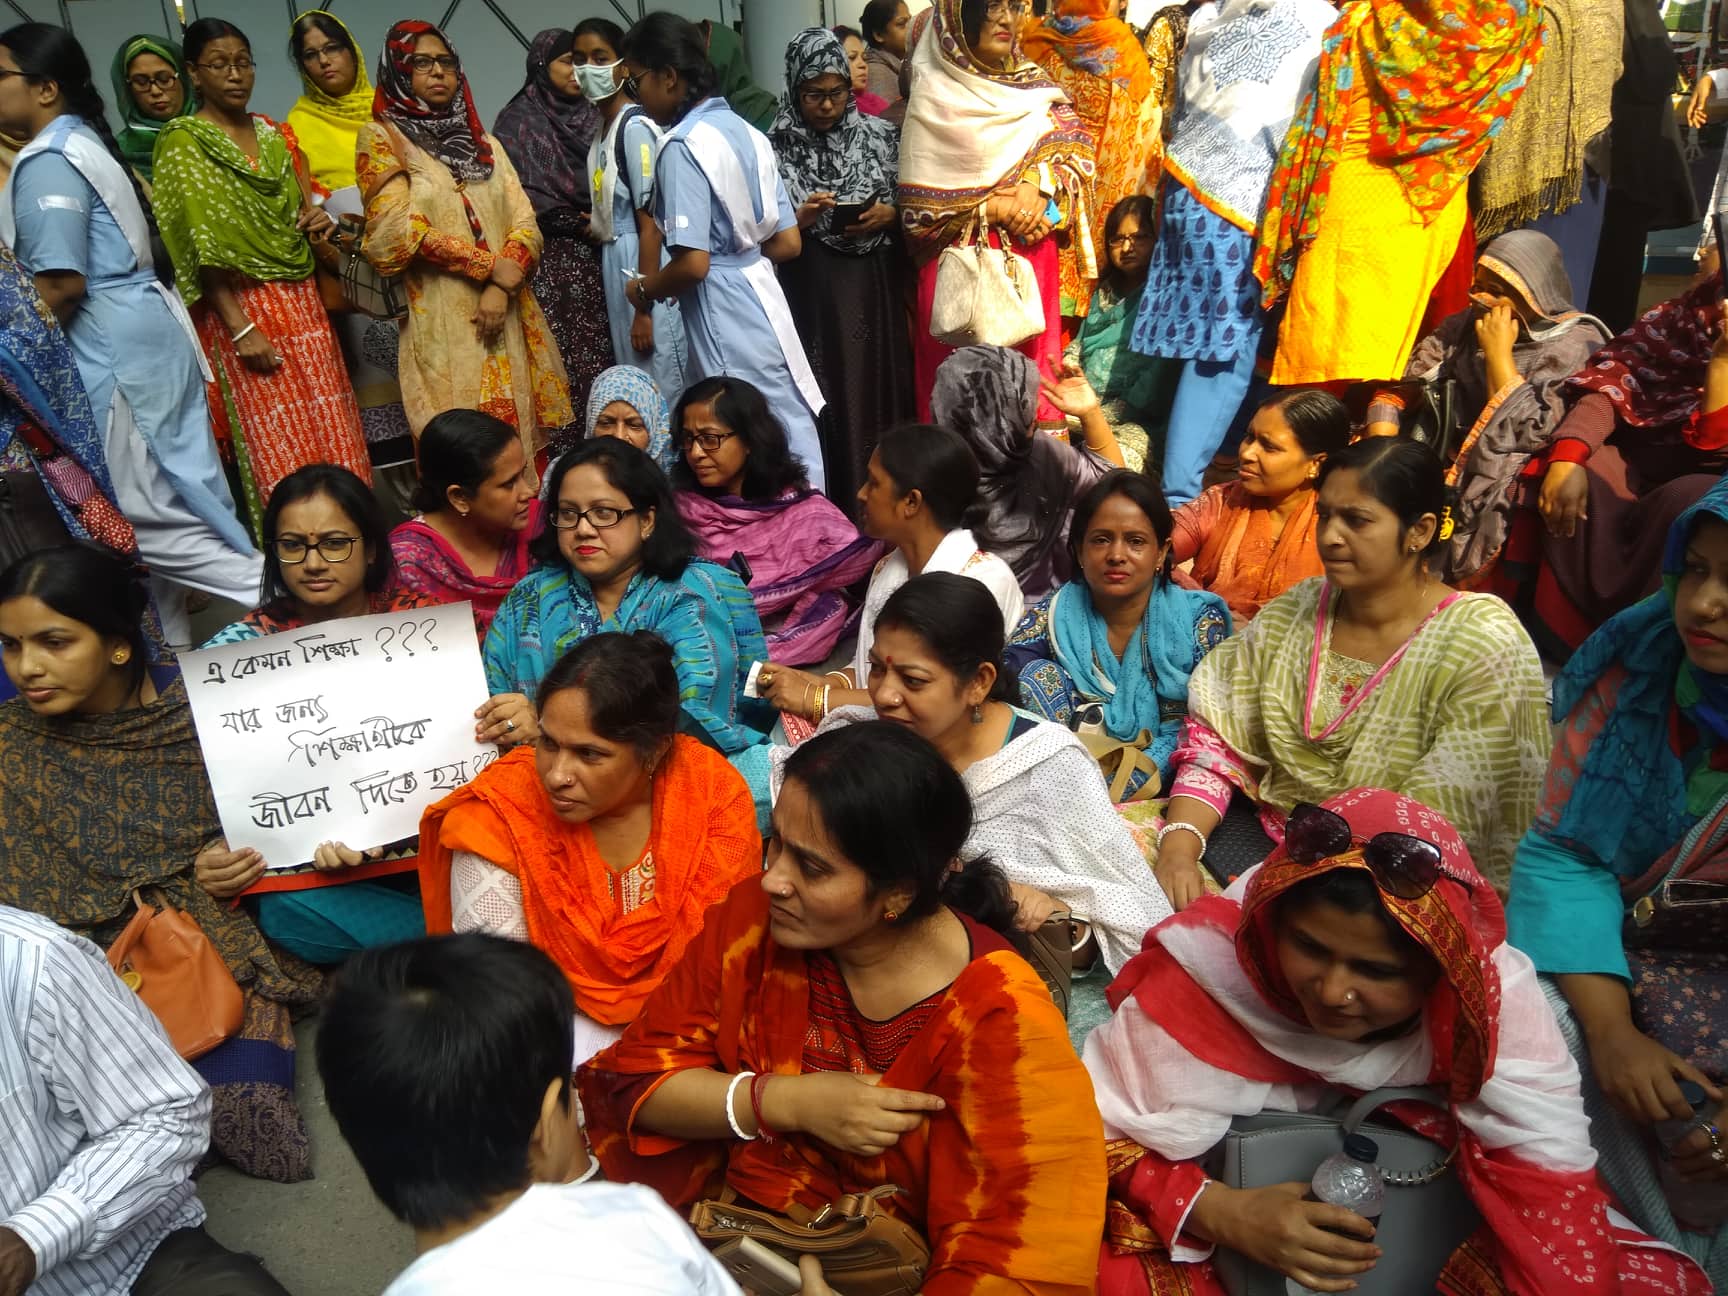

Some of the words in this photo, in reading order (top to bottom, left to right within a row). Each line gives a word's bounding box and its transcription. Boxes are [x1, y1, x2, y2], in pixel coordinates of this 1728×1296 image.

[203, 661, 226, 684] এ
[231, 649, 292, 679] কেমন
[294, 634, 362, 663] শিক্ষা
[375, 618, 438, 662] ???
[219, 708, 262, 734] যার
[275, 694, 329, 724] জন্য
[249, 785, 332, 829] জীবন
[350, 770, 418, 814] দিতে
